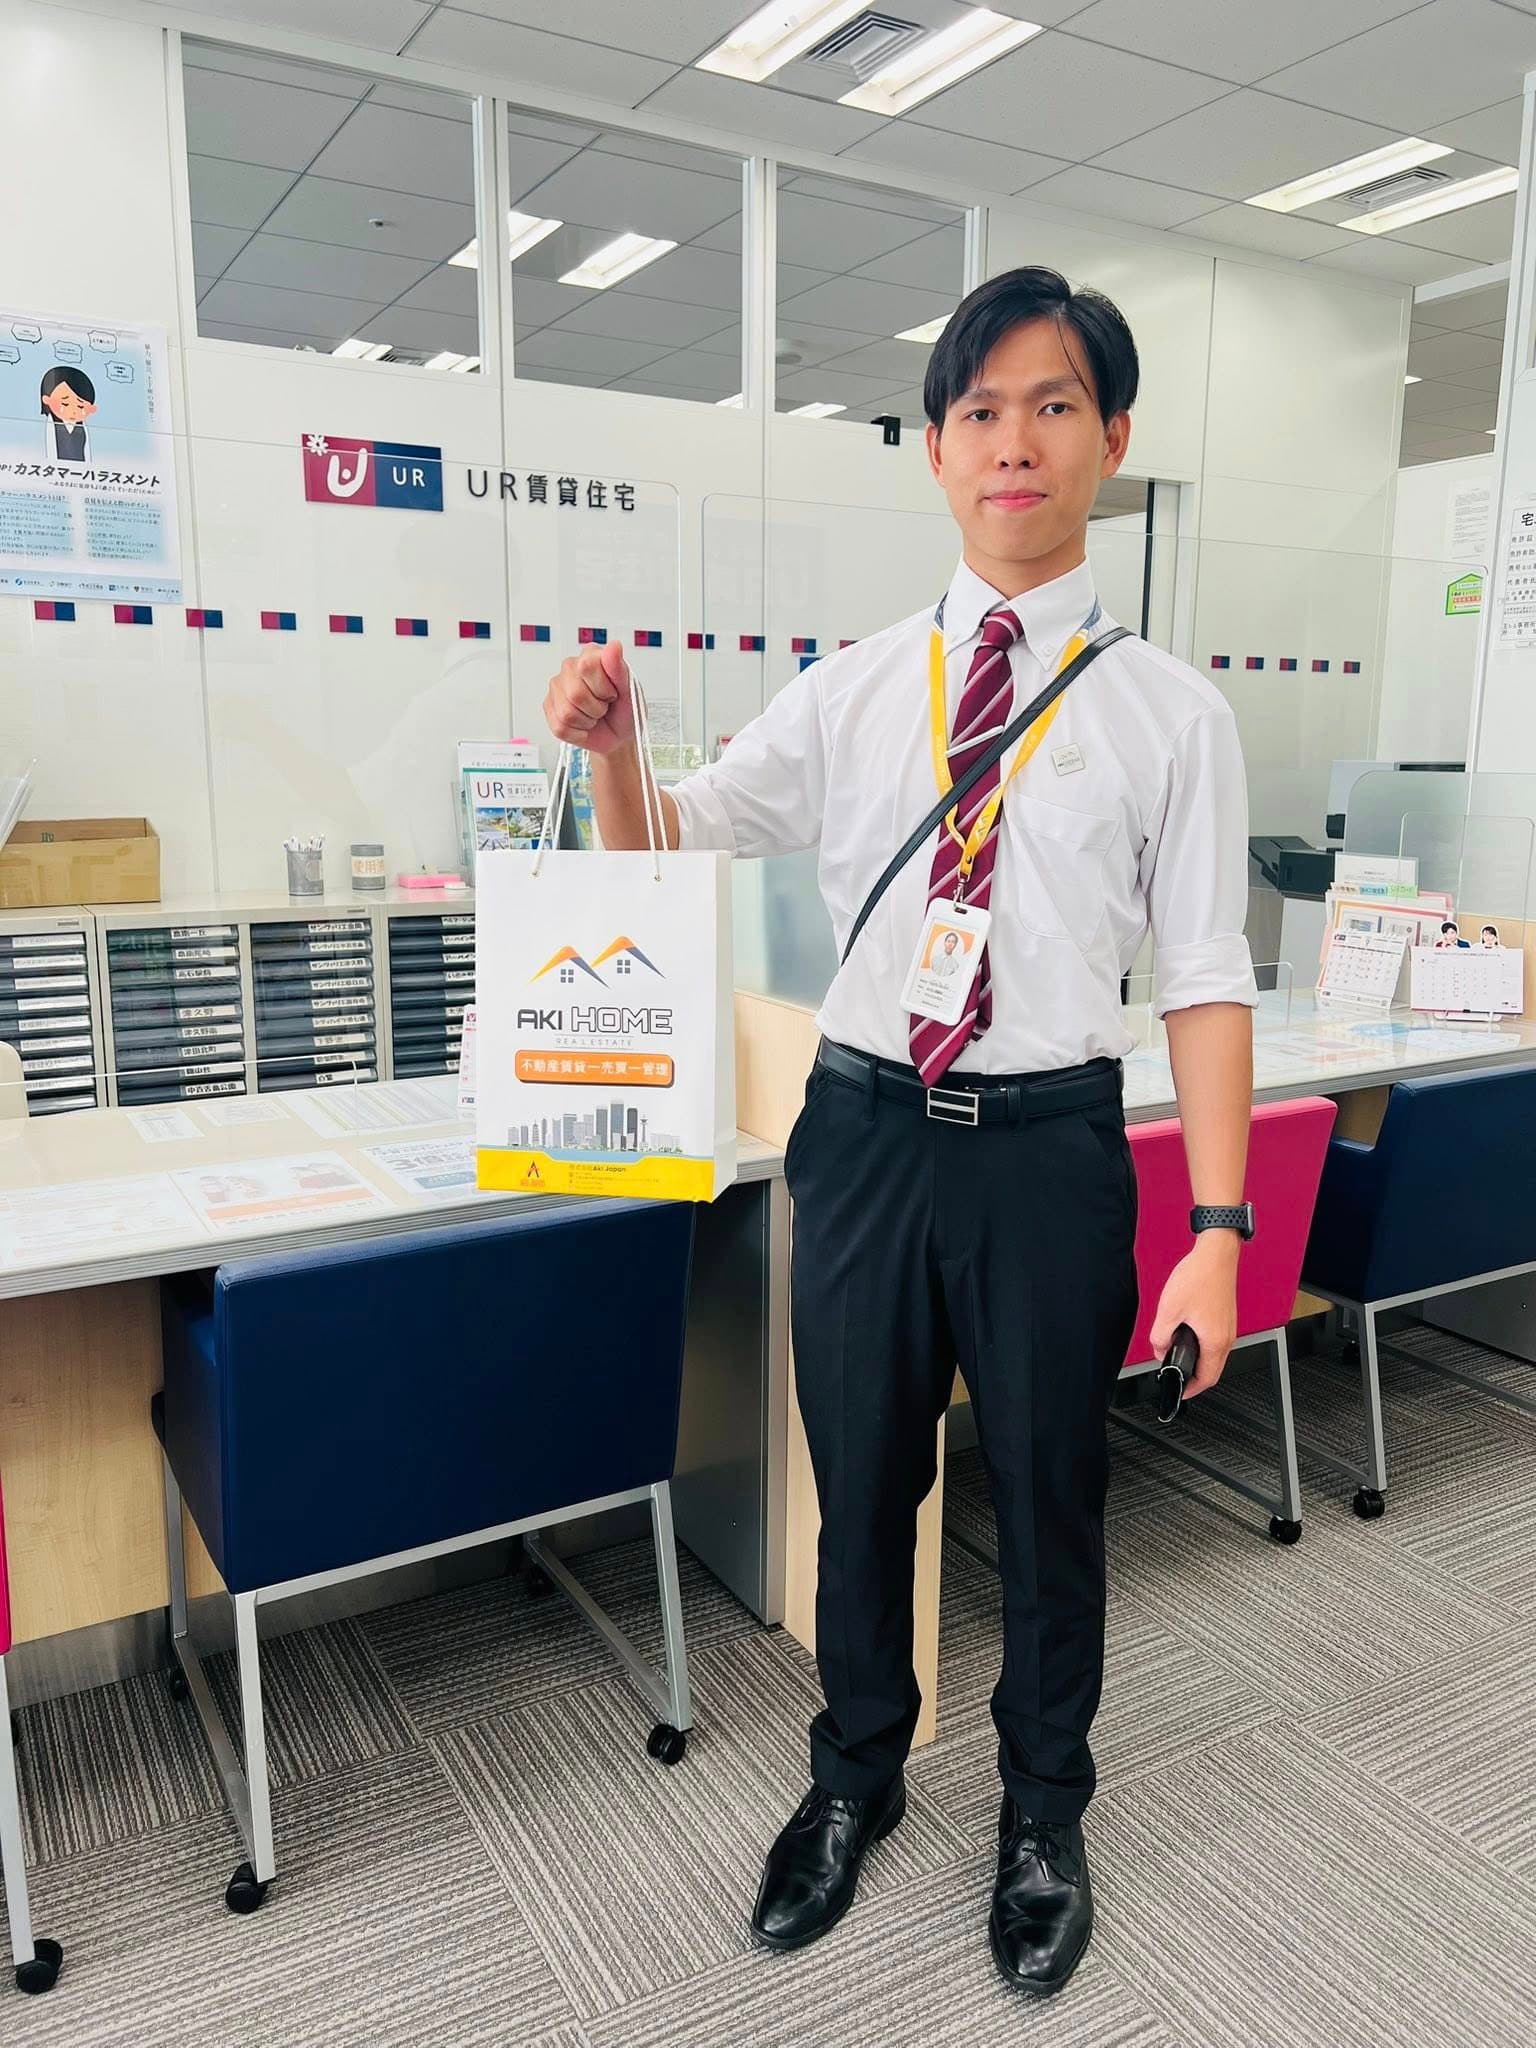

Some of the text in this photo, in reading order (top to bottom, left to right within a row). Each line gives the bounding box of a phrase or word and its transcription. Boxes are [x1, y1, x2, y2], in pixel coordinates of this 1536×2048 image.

[14, 463, 160, 487] カスタマーハラスメント
[392, 466, 425, 487] UR
[467, 468, 635, 511] UR賃貸住宅
[1520, 512, 1536, 526] 宅
[477, 782, 505, 799] UR
[517, 1006, 672, 1034] AKI HOME
